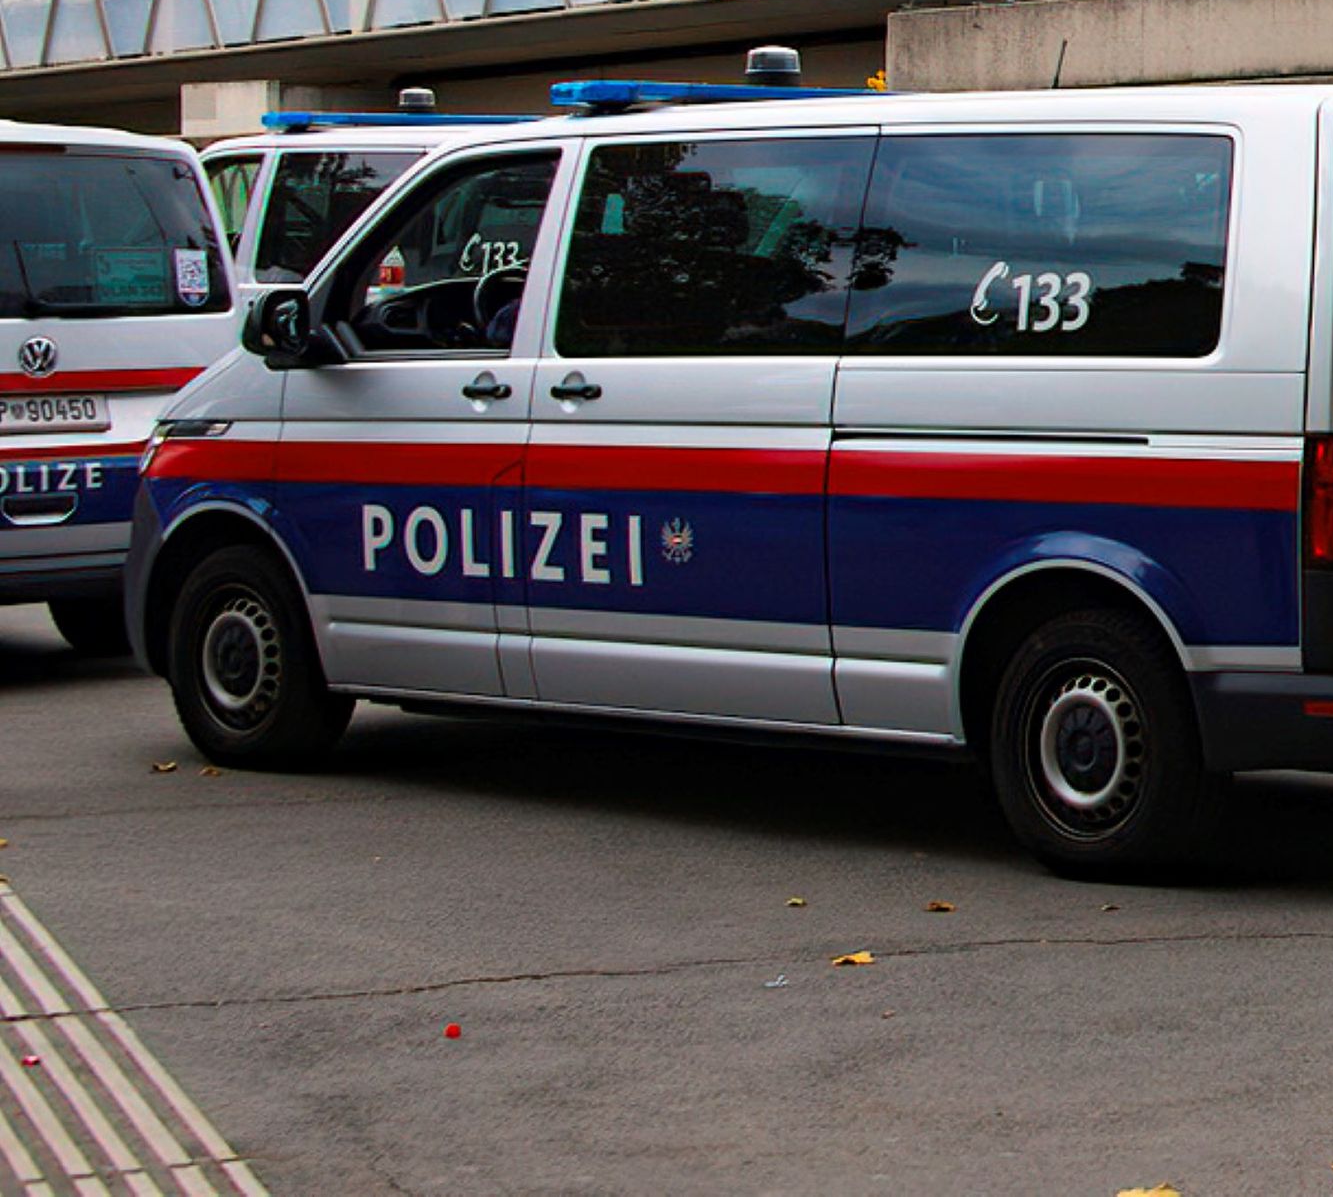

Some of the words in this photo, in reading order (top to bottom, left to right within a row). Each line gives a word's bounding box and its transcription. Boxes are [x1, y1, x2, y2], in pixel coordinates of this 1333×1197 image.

[1012, 271, 1092, 332] 133
[25, 397, 97, 422] 90450
[361, 504, 643, 586] POLIZEI
